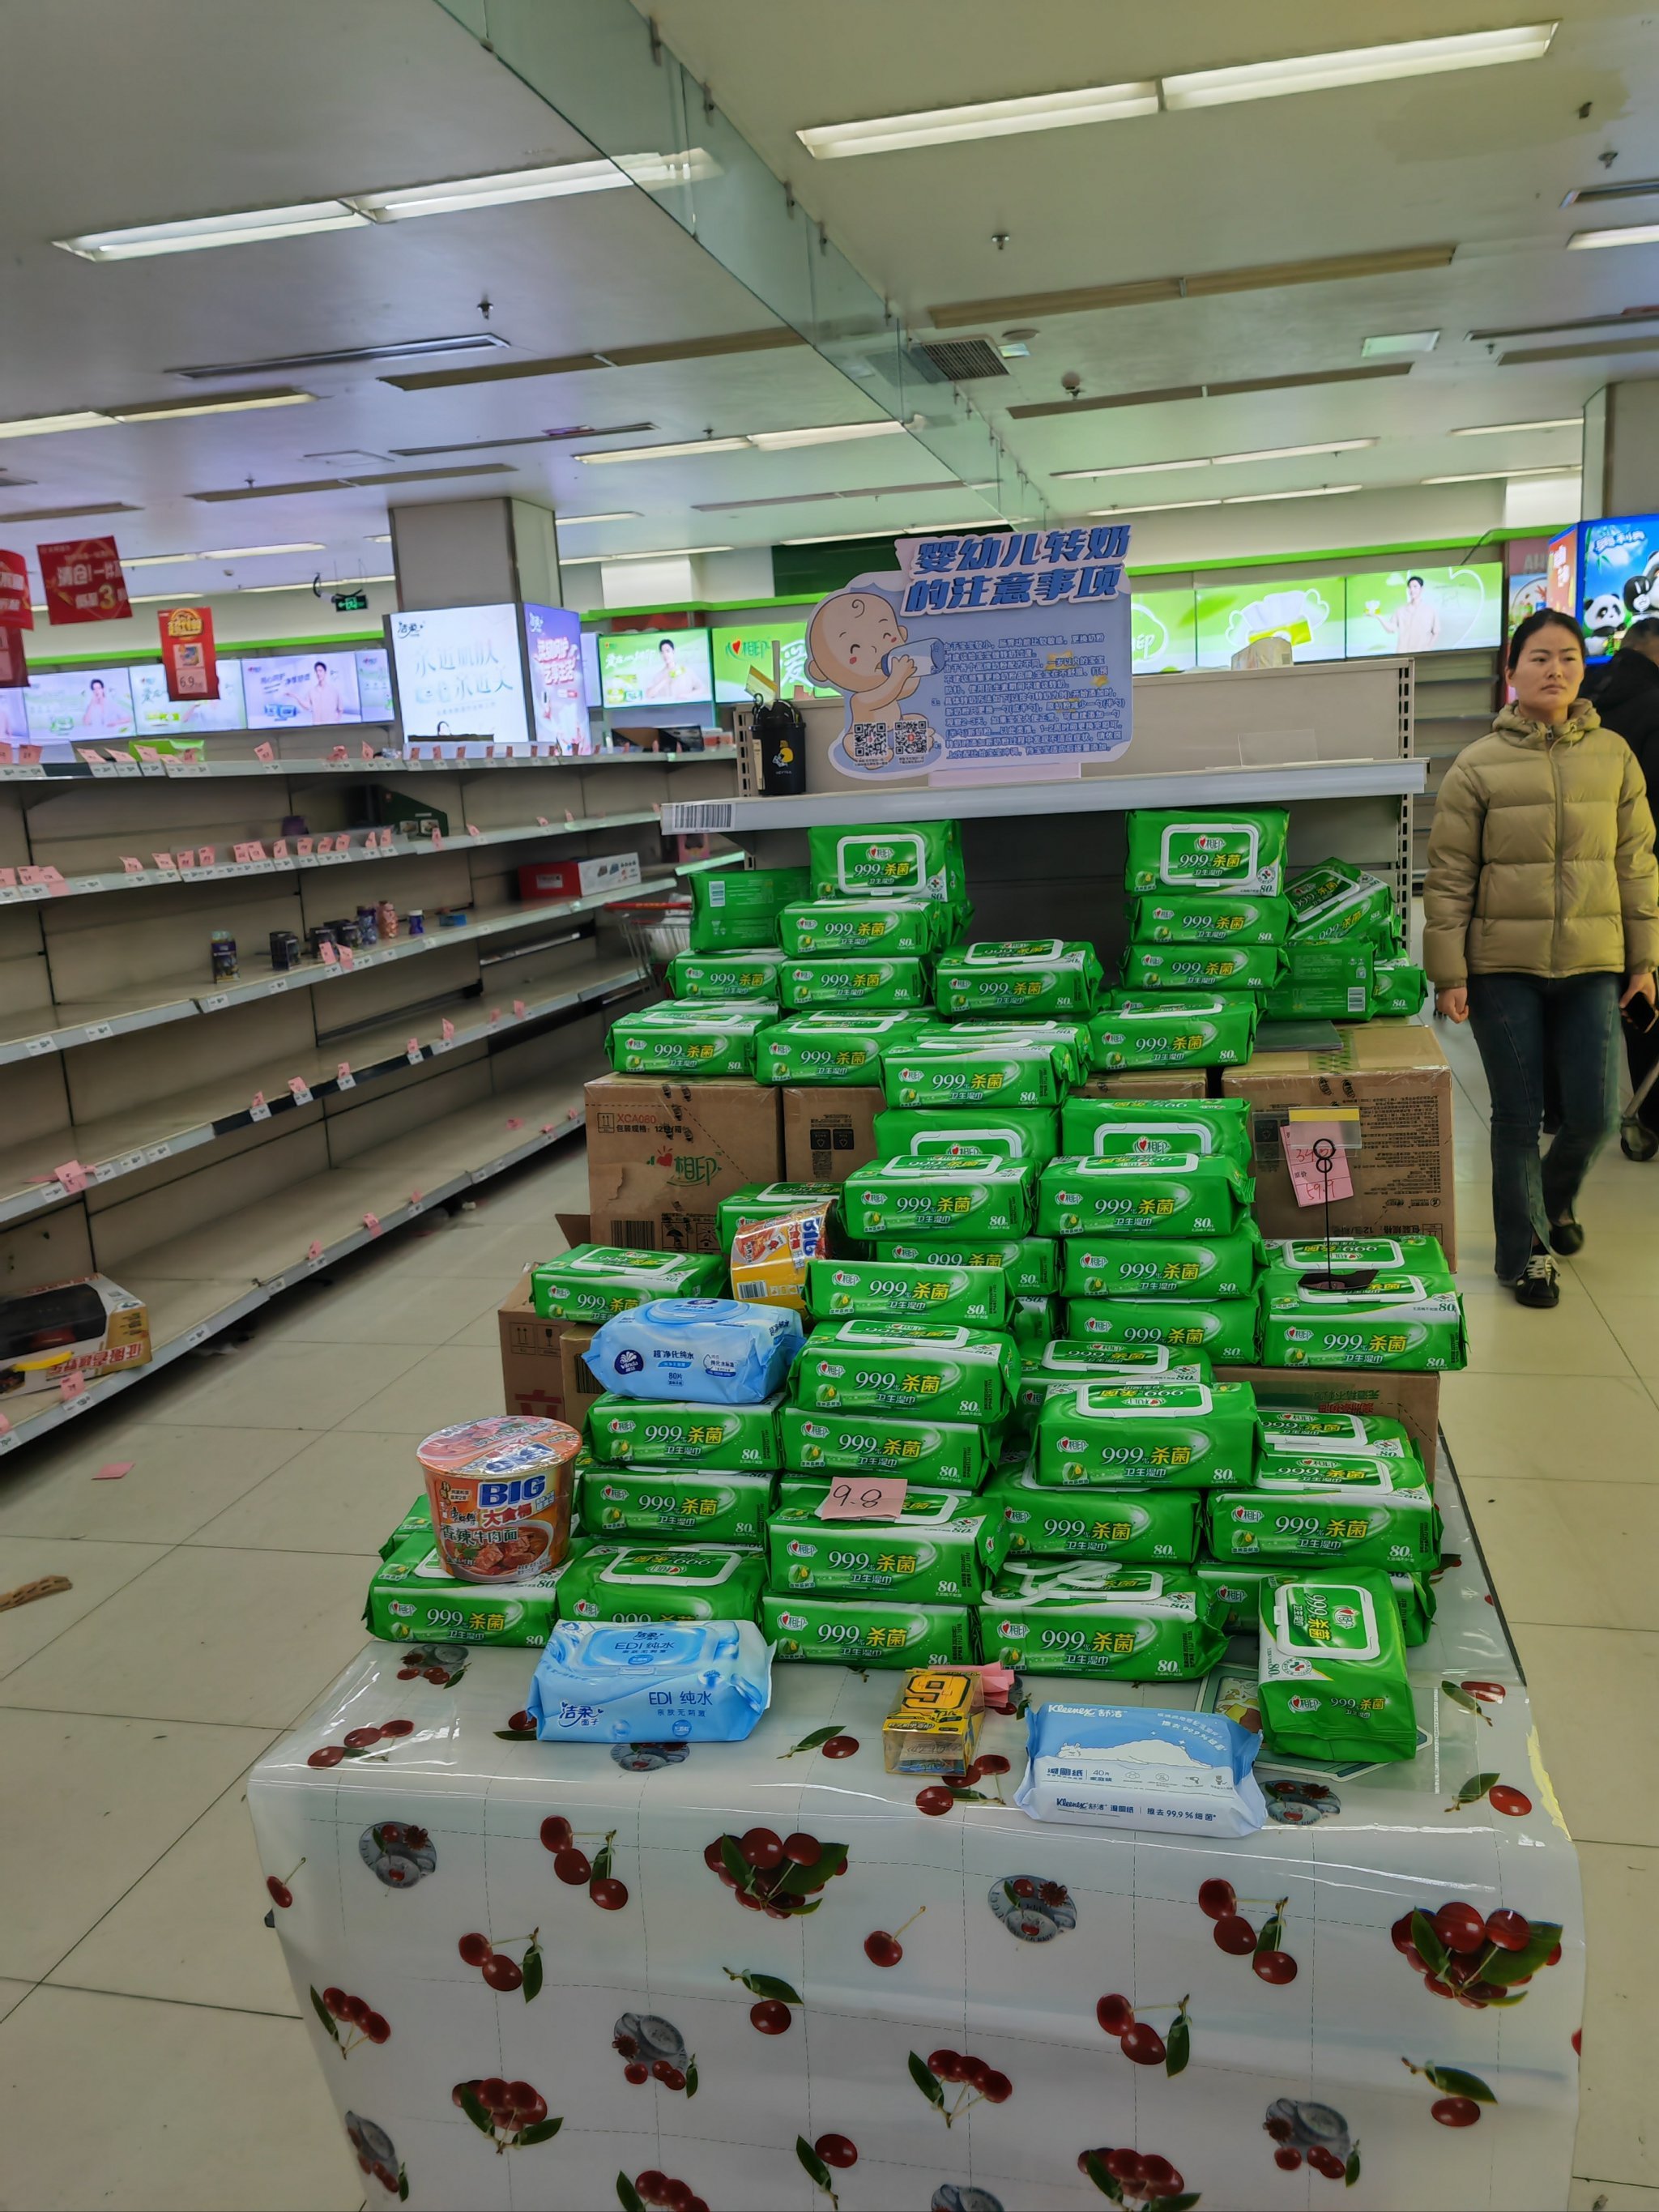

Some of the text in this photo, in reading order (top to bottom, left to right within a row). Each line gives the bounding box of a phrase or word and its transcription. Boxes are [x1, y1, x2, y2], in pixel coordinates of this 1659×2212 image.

[915, 525, 1131, 573] 婴幼儿转奶
[905, 565, 1124, 613] 的注意事项
[916, 1215, 951, 1224] 卫生湿巾
[1115, 1217, 1153, 1226] 卫生湿巾
[803, 1217, 820, 1256] BIG
[1140, 1281, 1177, 1290] 卫生湿巾
[888, 1301, 926, 1310] 卫生湿巾
[1344, 1354, 1384, 1363] 卫生湿巾
[876, 1393, 916, 1404] 卫生湿巾
[664, 1446, 702, 1456] 卫生湿巾
[858, 1457, 898, 1468] 卫生湿巾
[1124, 1468, 1166, 1477] 卫生湿巾
[480, 1475, 546, 1507] BIG
[483, 1503, 532, 1527] 大食桶
[657, 1515, 696, 1527] 卫生湿巾
[441, 1525, 518, 1546] 香辣牛肉面
[1067, 1541, 1107, 1551] 卫生湿巾
[1297, 1539, 1341, 1549] 卫生湿巾
[851, 1575, 892, 1585] 卫生湿巾
[448, 1630, 484, 1640] 卫生湿巾
[615, 1641, 675, 1650] EDI 纯水
[841, 1647, 882, 1657] 卫生湿巾
[1066, 1655, 1109, 1665] 卫生湿巾
[649, 1690, 713, 1706] EDI 纯水
[1048, 1704, 1096, 1717] Kleenex
[1056, 1798, 1088, 1809] Kleenex
